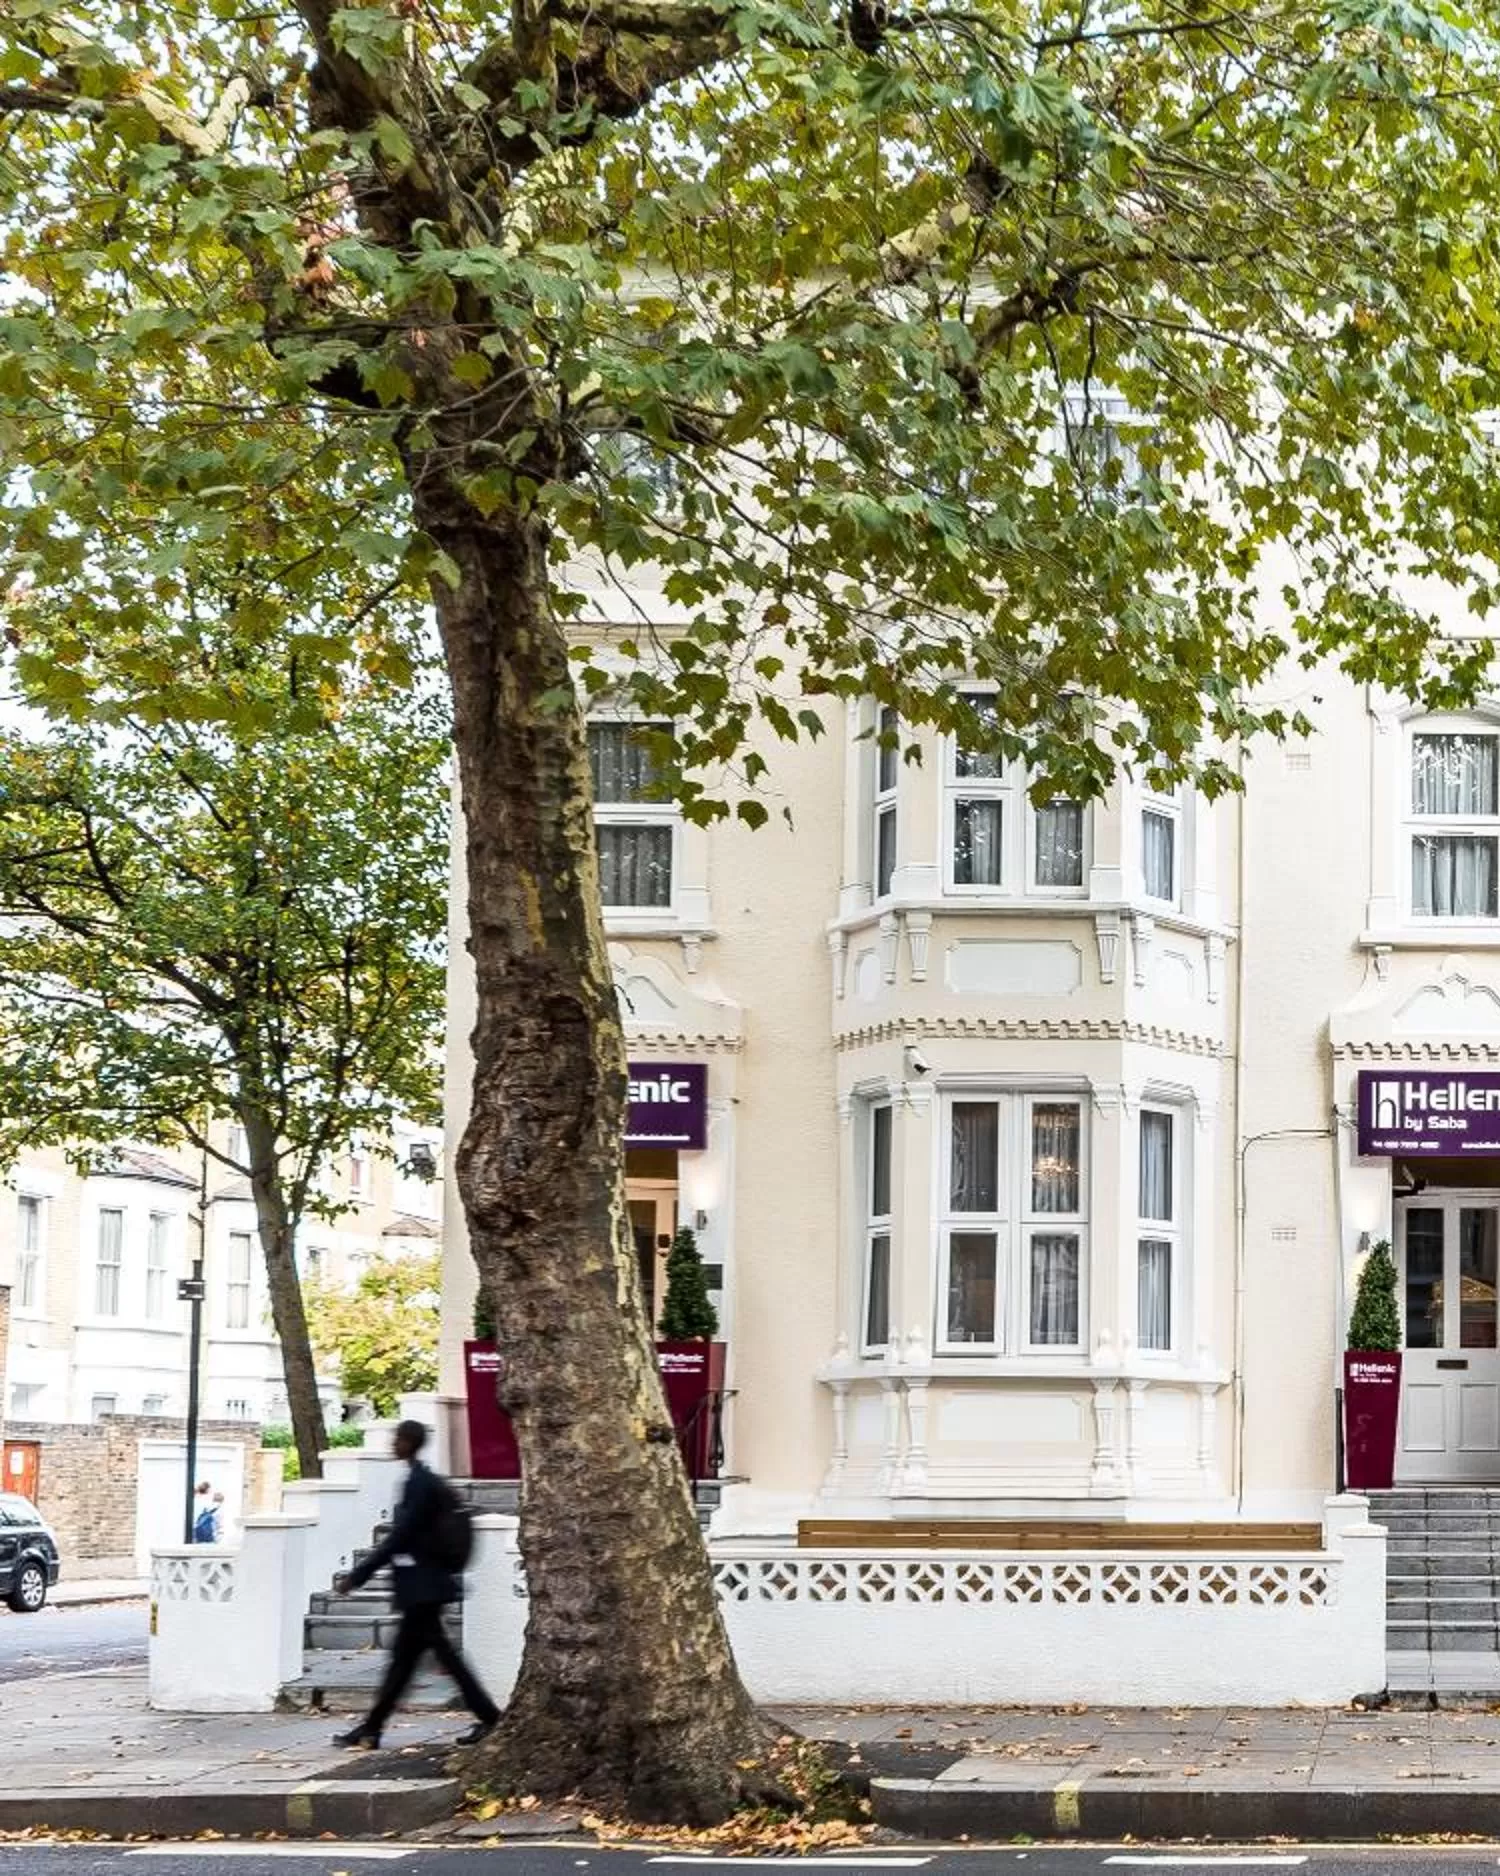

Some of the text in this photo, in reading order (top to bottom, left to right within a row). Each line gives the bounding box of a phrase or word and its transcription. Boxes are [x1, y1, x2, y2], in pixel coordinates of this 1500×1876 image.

[628, 1073, 690, 1102] enic
[1405, 1116, 1467, 1132] by Saba
